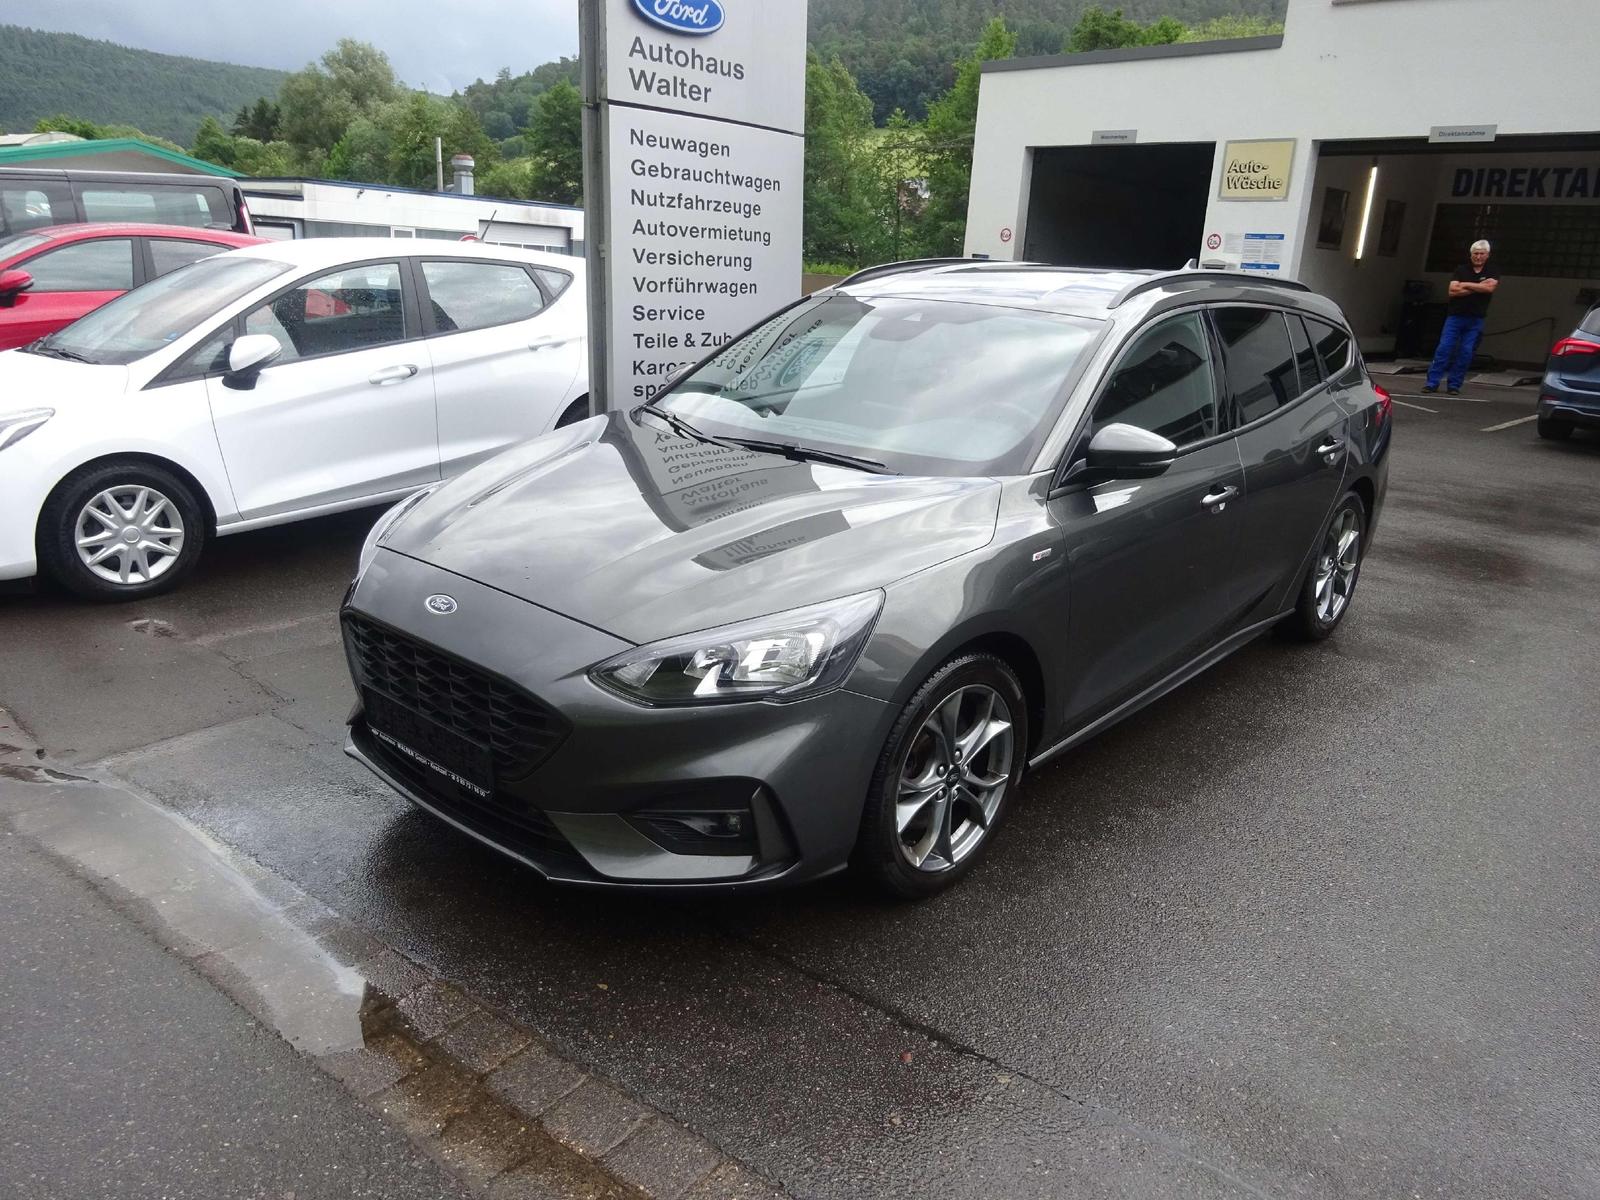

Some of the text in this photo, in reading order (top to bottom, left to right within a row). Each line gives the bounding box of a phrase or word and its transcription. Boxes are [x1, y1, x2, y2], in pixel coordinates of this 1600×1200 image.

[654, 0, 709, 25] Ford
[628, 35, 745, 81] Autohaus
[628, 67, 712, 104] Walter
[630, 127, 730, 159] Neuwagen
[630, 158, 781, 193] Gebrauchtwagen
[1227, 159, 1269, 174] Auto-
[1226, 174, 1283, 190] Wäsche
[630, 188, 762, 219] Nutzfahrzeuge
[632, 218, 772, 247] Autovermietung
[632, 247, 753, 272] Versicherung
[632, 276, 758, 298] Vorführwagen
[632, 304, 706, 322] Service
[632, 331, 732, 349] Teile & Zub
[632, 359, 697, 376] Karo
[633, 383, 667, 401] sp
